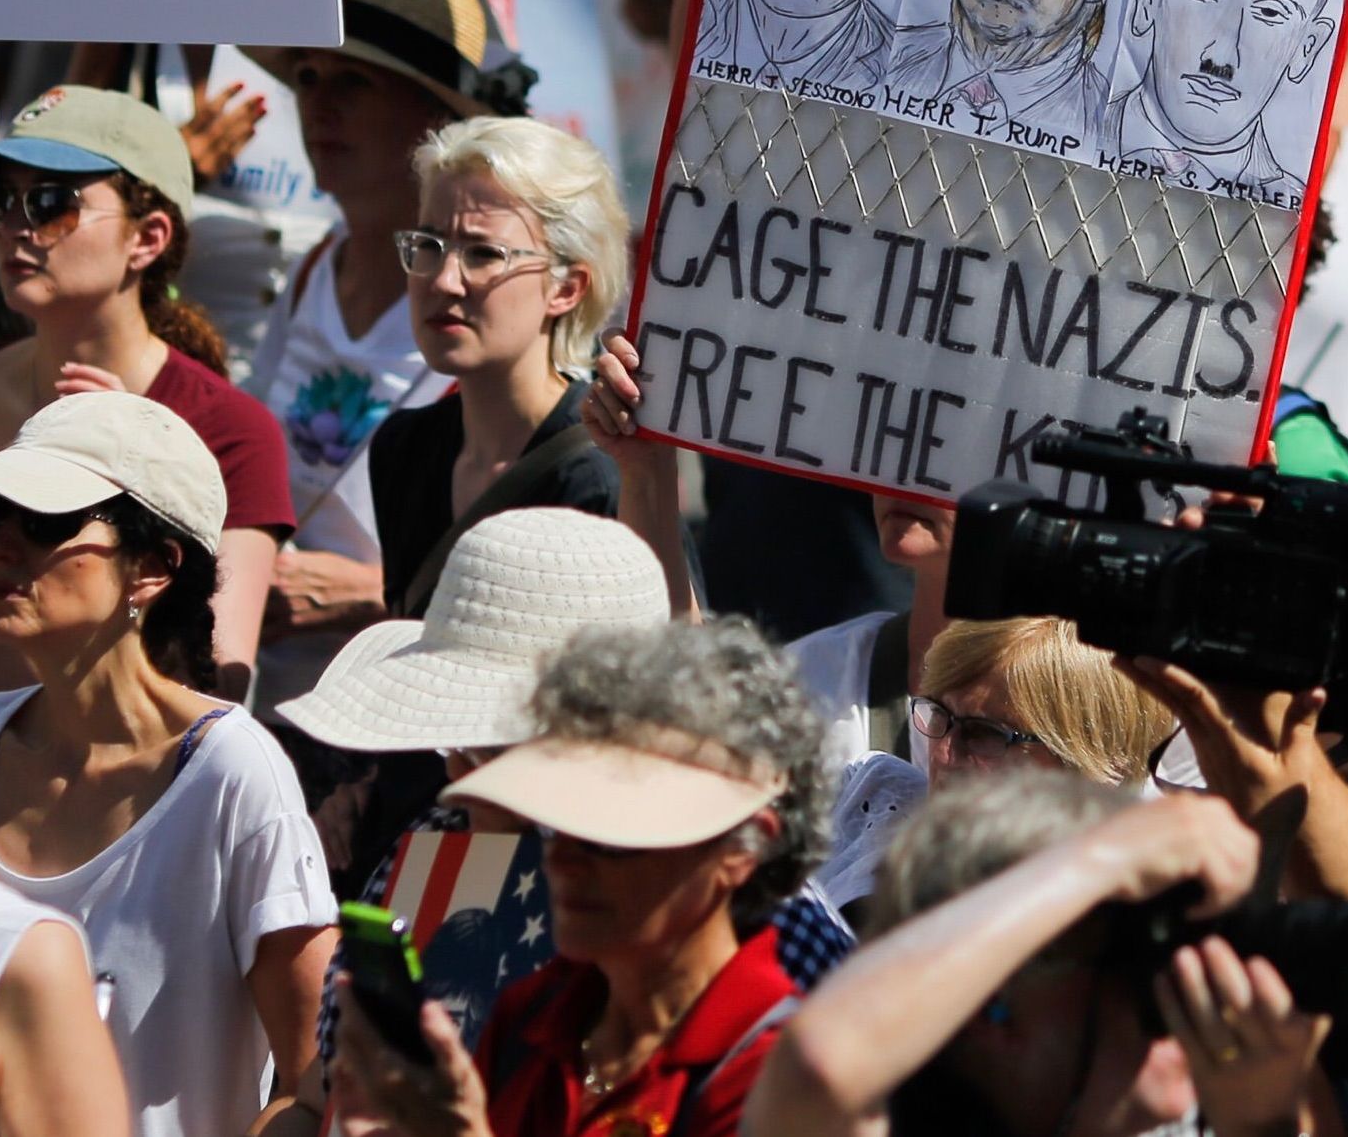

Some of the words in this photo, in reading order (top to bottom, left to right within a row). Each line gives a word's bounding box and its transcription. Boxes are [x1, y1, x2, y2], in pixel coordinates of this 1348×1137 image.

[696, 58, 752, 84] HERR
[761, 75, 778, 90] J.
[883, 84, 954, 128] HERR
[970, 111, 997, 136] T.
[1098, 150, 1166, 180] HERR
[1180, 170, 1200, 190] S.
[1207, 177, 1301, 210] MILLER
[650, 182, 852, 324] CAGE
[874, 229, 989, 354] THE
[992, 261, 1261, 402] NAZIS.
[635, 321, 835, 468] FREE
[850, 372, 966, 492] THE
